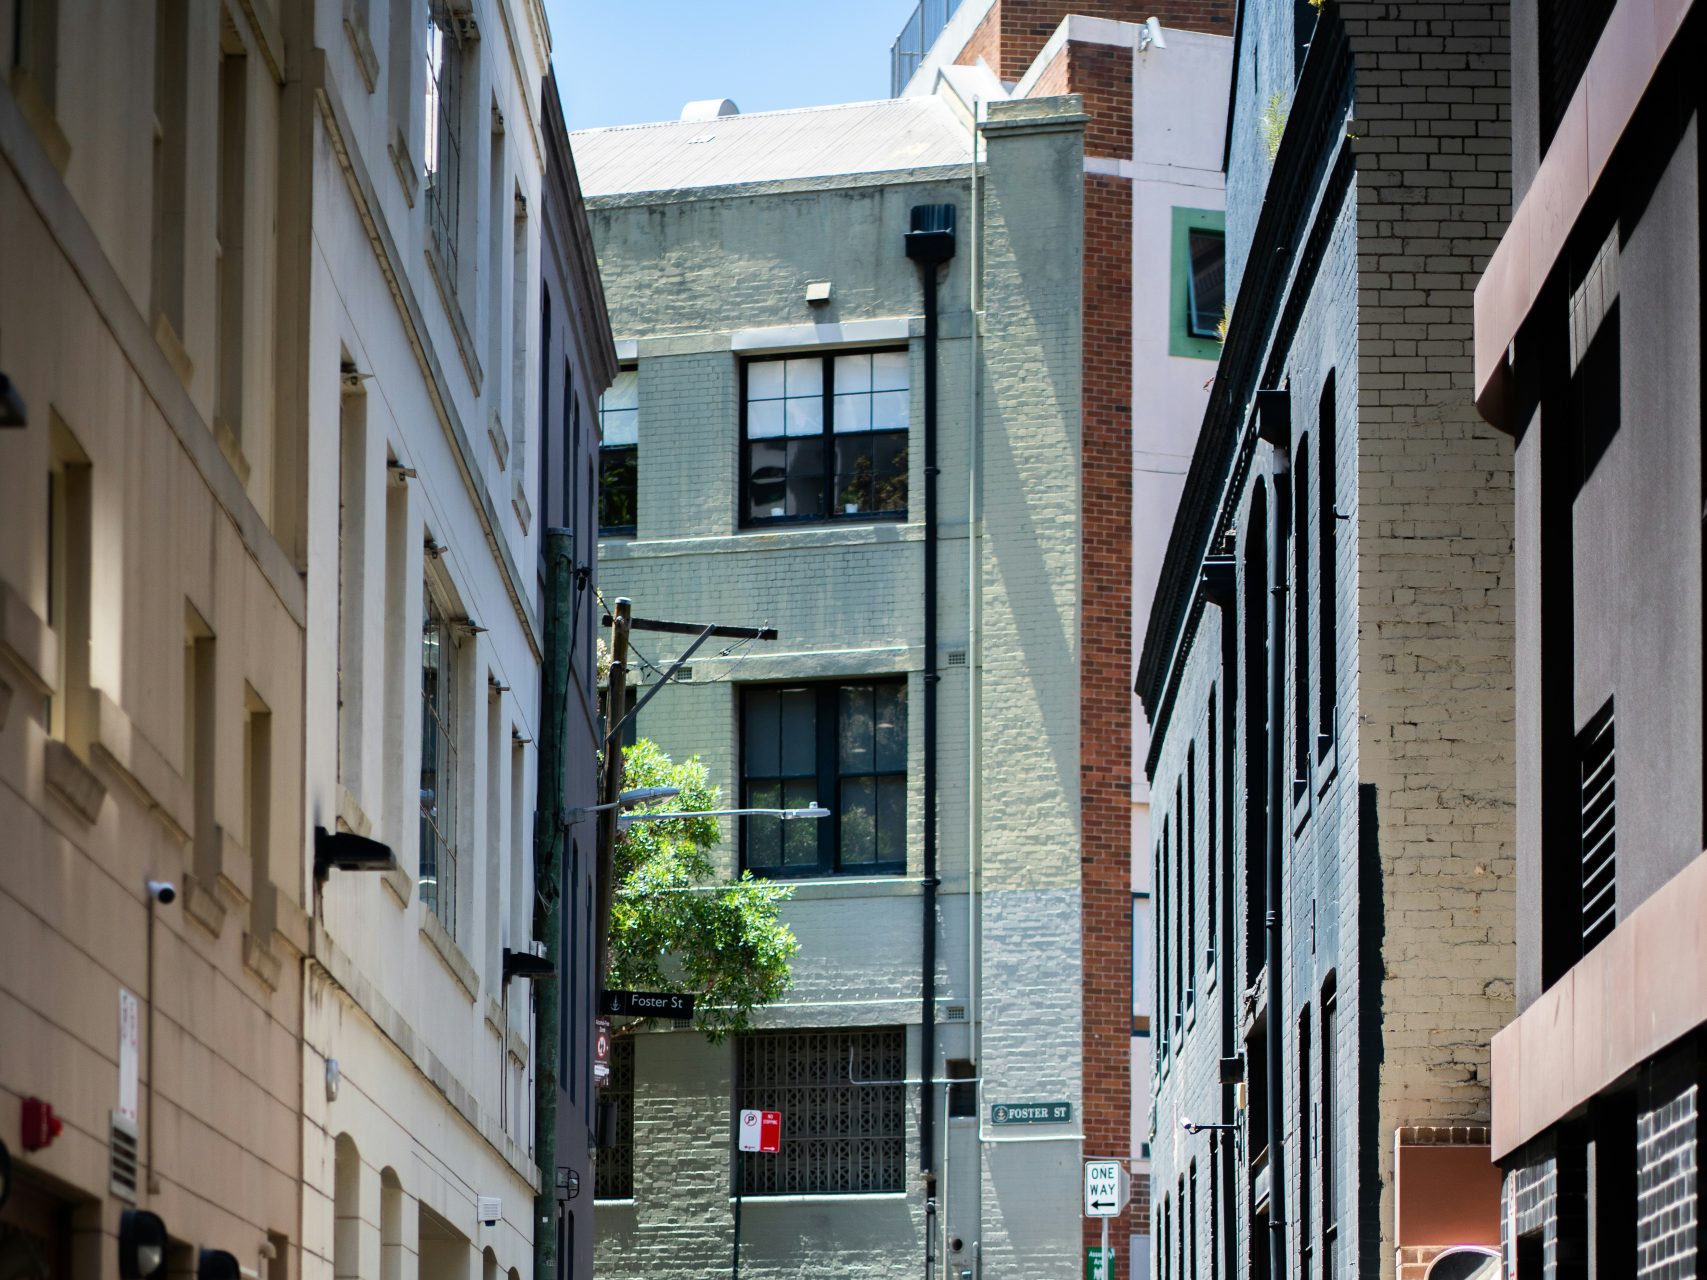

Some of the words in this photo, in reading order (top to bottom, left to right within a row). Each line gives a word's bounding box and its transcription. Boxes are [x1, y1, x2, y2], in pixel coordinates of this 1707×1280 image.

[631, 994, 668, 1007] Foster
[670, 996, 683, 1009] St
[1009, 1107, 1049, 1119] FOSTER
[1053, 1106, 1067, 1118] ST
[1091, 1167, 1115, 1180] ONE
[1089, 1183, 1116, 1195] WAY
